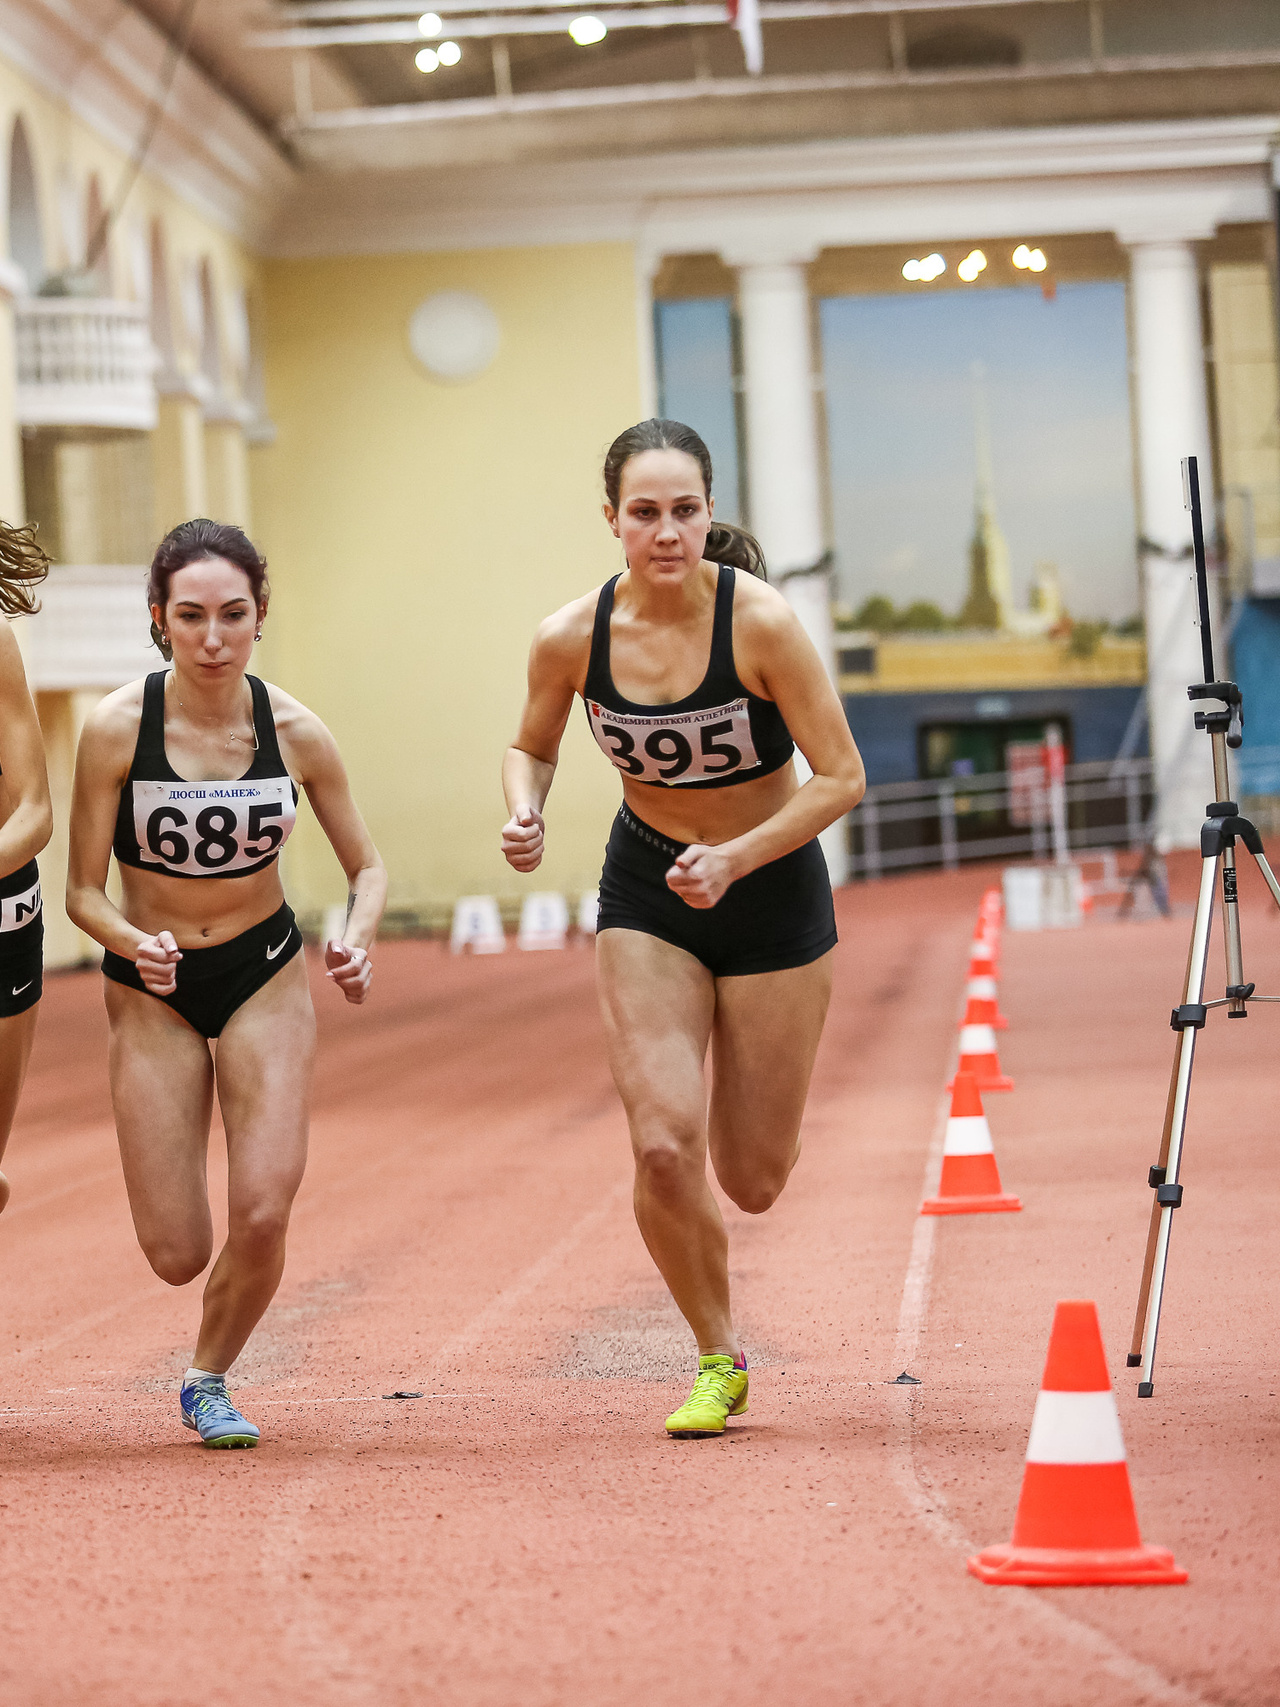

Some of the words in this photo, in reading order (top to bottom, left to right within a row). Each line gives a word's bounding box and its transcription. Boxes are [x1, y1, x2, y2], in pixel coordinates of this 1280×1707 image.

[601, 712, 651, 726] АКАДЕМИЯ
[653, 717, 691, 726] ЛЕГКОЙ
[694, 704, 744, 723] АТЛЕТИКИ
[601, 719, 742, 778] 395
[169, 790, 206, 801] ДЮСШ
[208, 788, 261, 799] «МАНЕЖ»
[146, 802, 284, 868] 685
